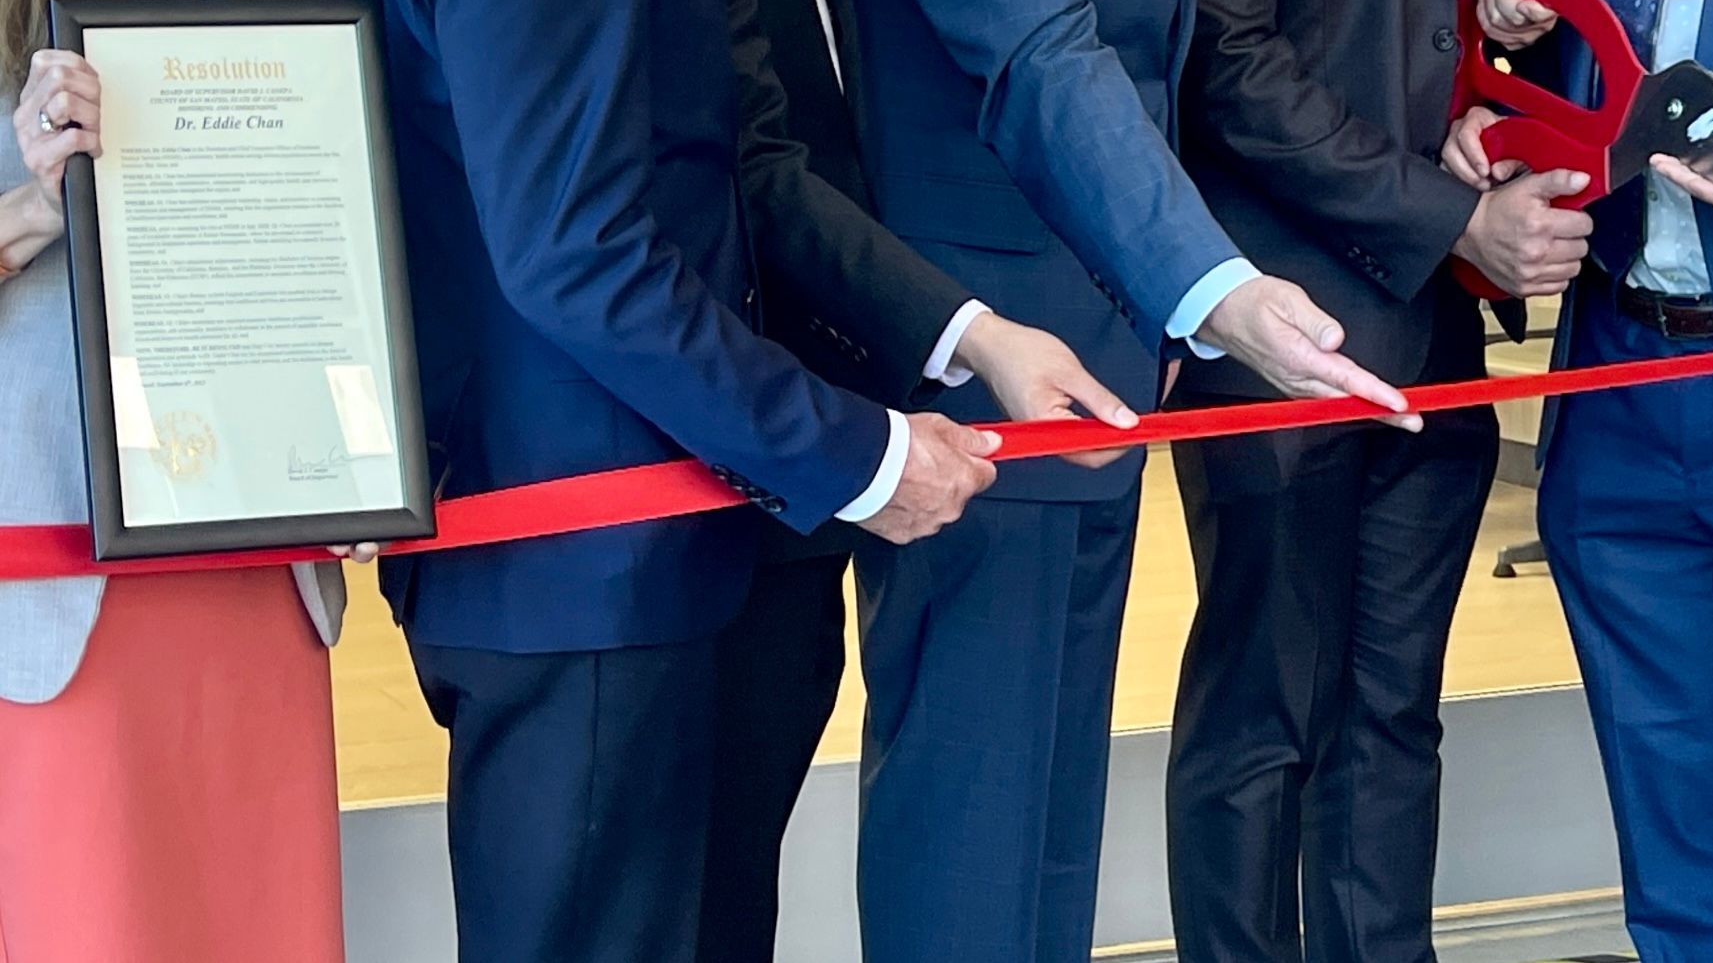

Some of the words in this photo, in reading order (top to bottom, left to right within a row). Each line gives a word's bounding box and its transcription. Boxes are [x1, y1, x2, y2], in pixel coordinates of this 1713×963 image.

[162, 56, 286, 81] Resolution
[174, 116, 196, 131] Dr.
[201, 116, 241, 130] Eddie
[246, 115, 284, 130] Chan
